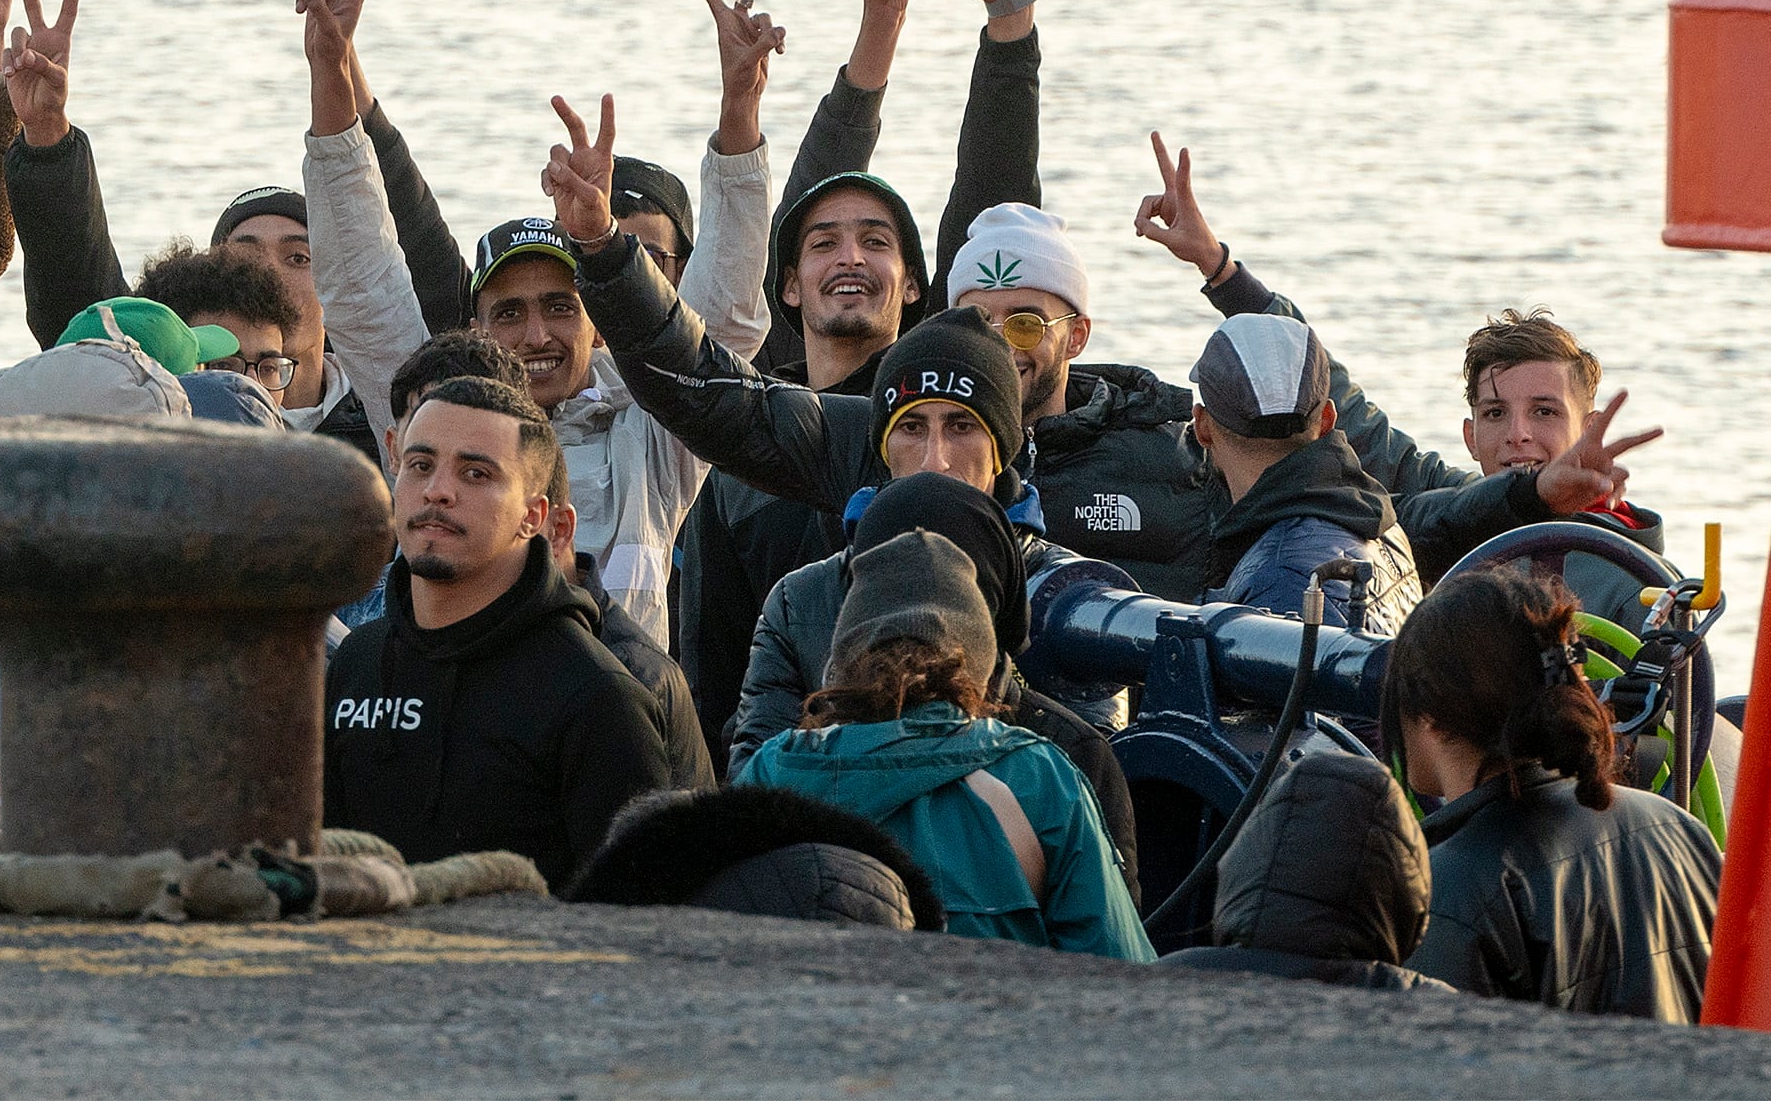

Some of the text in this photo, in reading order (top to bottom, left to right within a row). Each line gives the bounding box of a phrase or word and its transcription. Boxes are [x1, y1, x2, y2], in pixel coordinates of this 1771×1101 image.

[511, 231, 563, 248] YAMAHA
[1093, 493, 1117, 506] THE
[1075, 505, 1118, 519] NORTH
[1088, 518, 1117, 531] FACE
[334, 697, 424, 731] PARIS
